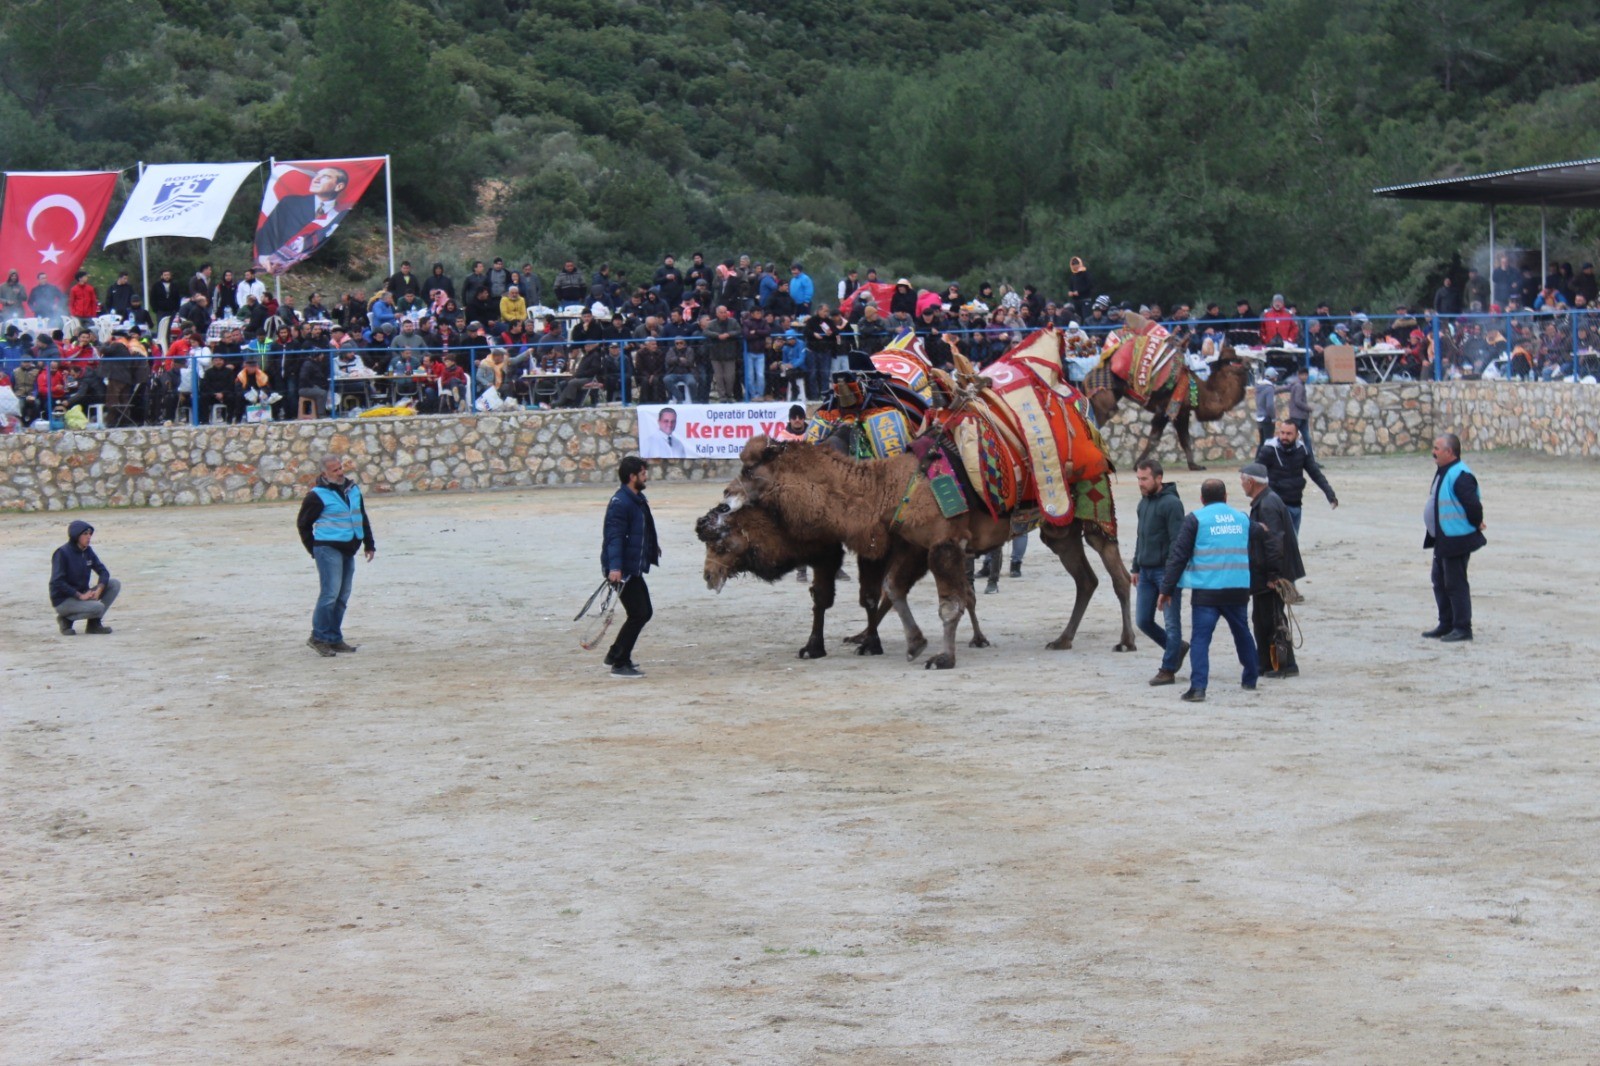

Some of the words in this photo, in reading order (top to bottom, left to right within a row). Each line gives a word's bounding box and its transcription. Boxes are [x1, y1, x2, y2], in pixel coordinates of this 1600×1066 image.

[164, 173, 219, 182] BODRUM
[706, 409, 745, 421] Operatör
[747, 409, 777, 419] Doktor
[685, 422, 754, 438] Kerem
[695, 444, 714, 454] Kalp
[716, 445, 726, 454] ve
[1214, 513, 1235, 523] SAHA
